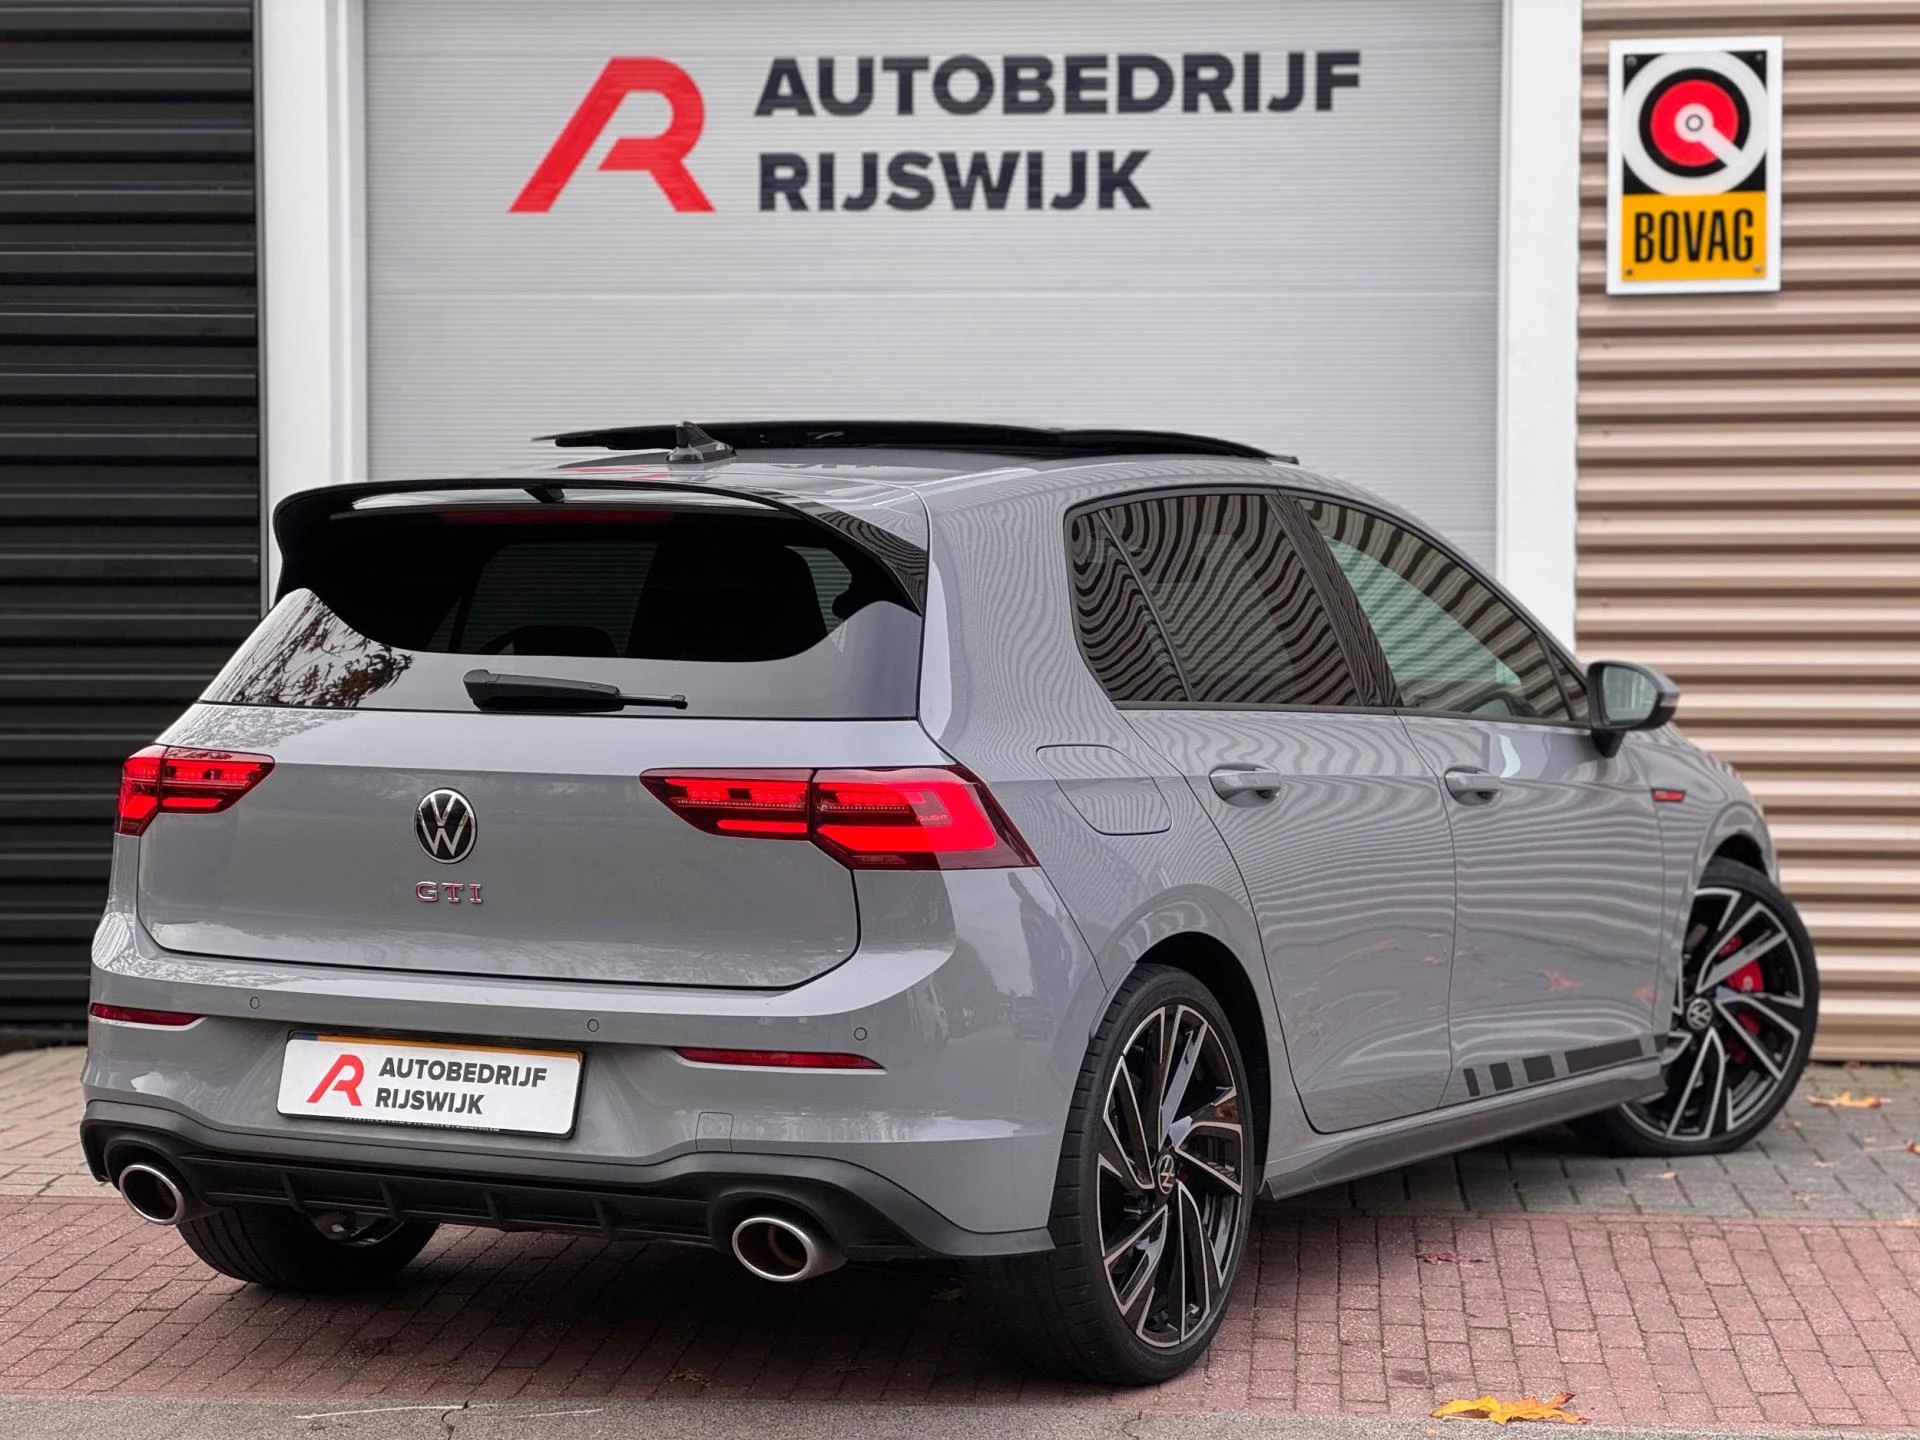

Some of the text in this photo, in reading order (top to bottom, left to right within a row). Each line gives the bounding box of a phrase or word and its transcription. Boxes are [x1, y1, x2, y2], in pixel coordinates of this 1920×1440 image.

[754, 50, 1361, 117] AUTOBEDRIJF
[759, 149, 1151, 212] RIJSWIJK
[1634, 208, 1754, 263] BOVAG
[415, 881, 482, 903] GTI
[378, 1056, 548, 1088] AUTOBEDRIJF
[375, 1087, 485, 1115] RIJSWIJK
